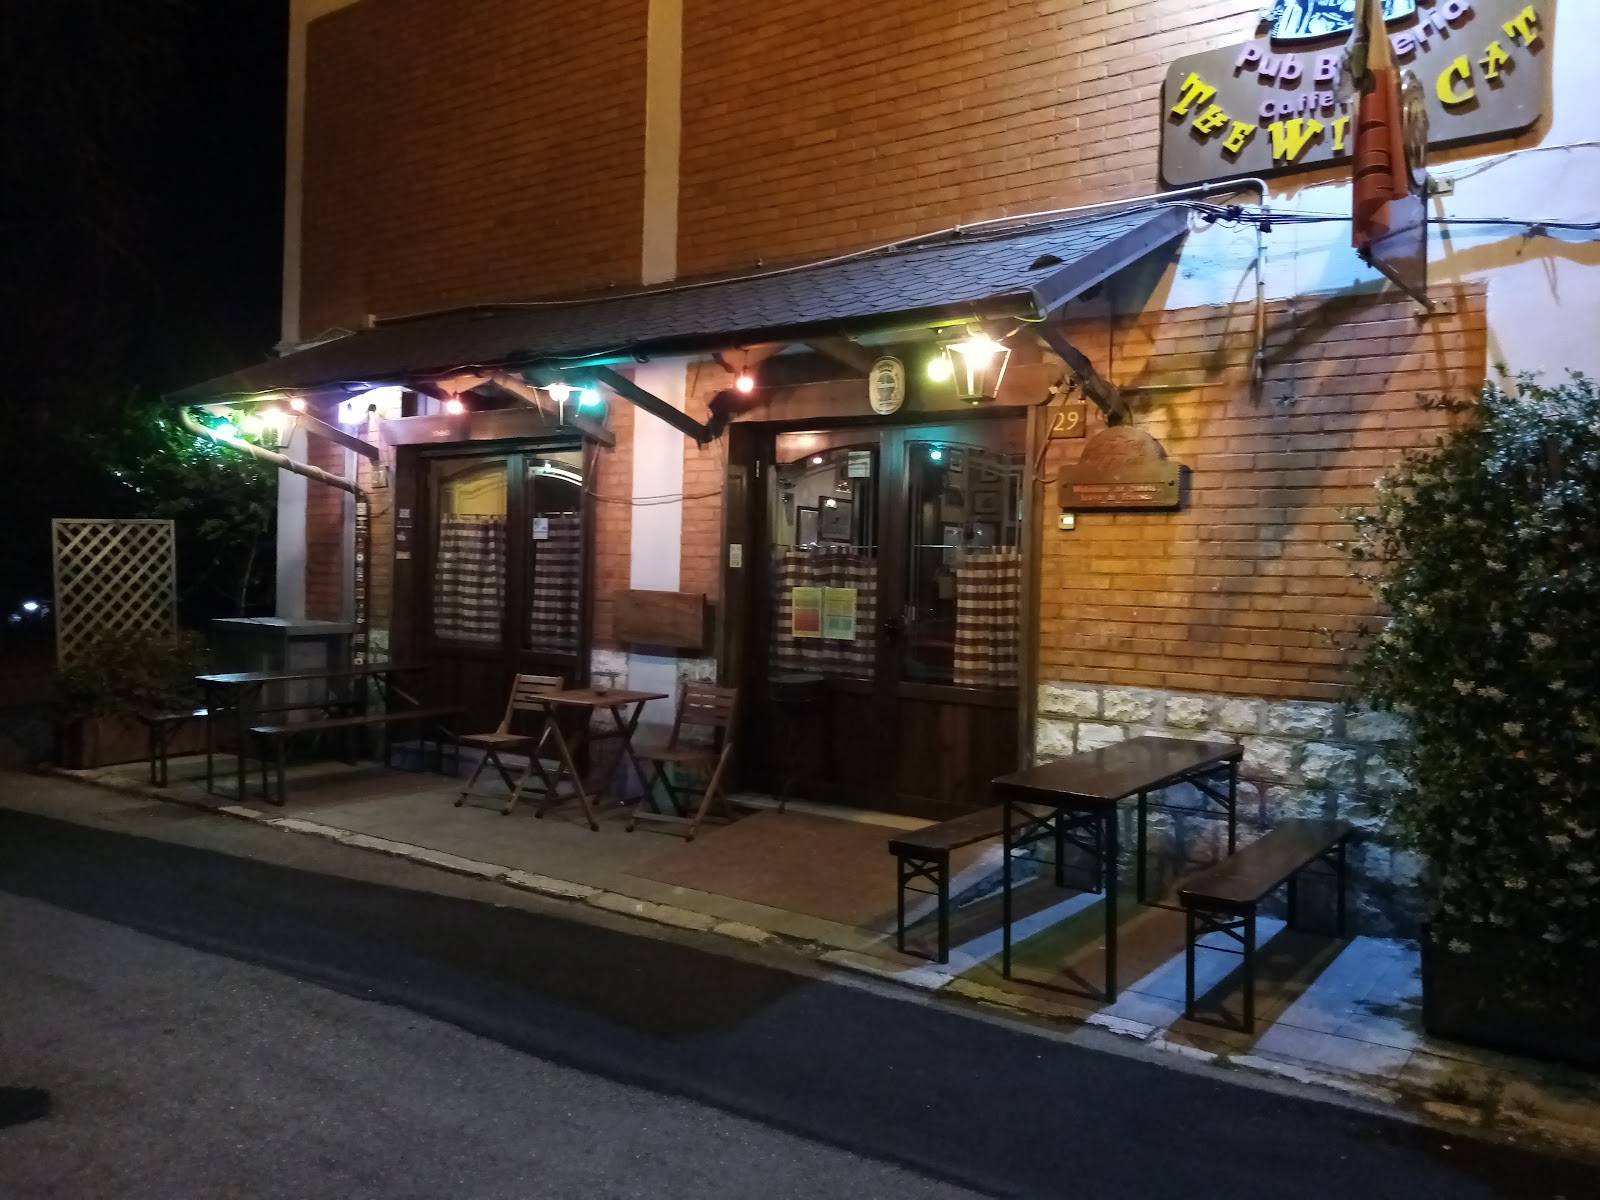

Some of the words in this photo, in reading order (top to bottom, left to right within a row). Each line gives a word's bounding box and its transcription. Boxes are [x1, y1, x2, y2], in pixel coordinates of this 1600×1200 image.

[1235, 43, 1303, 80] Pub
[1267, 116, 1350, 161] WI
[1053, 411, 1080, 431] 29
